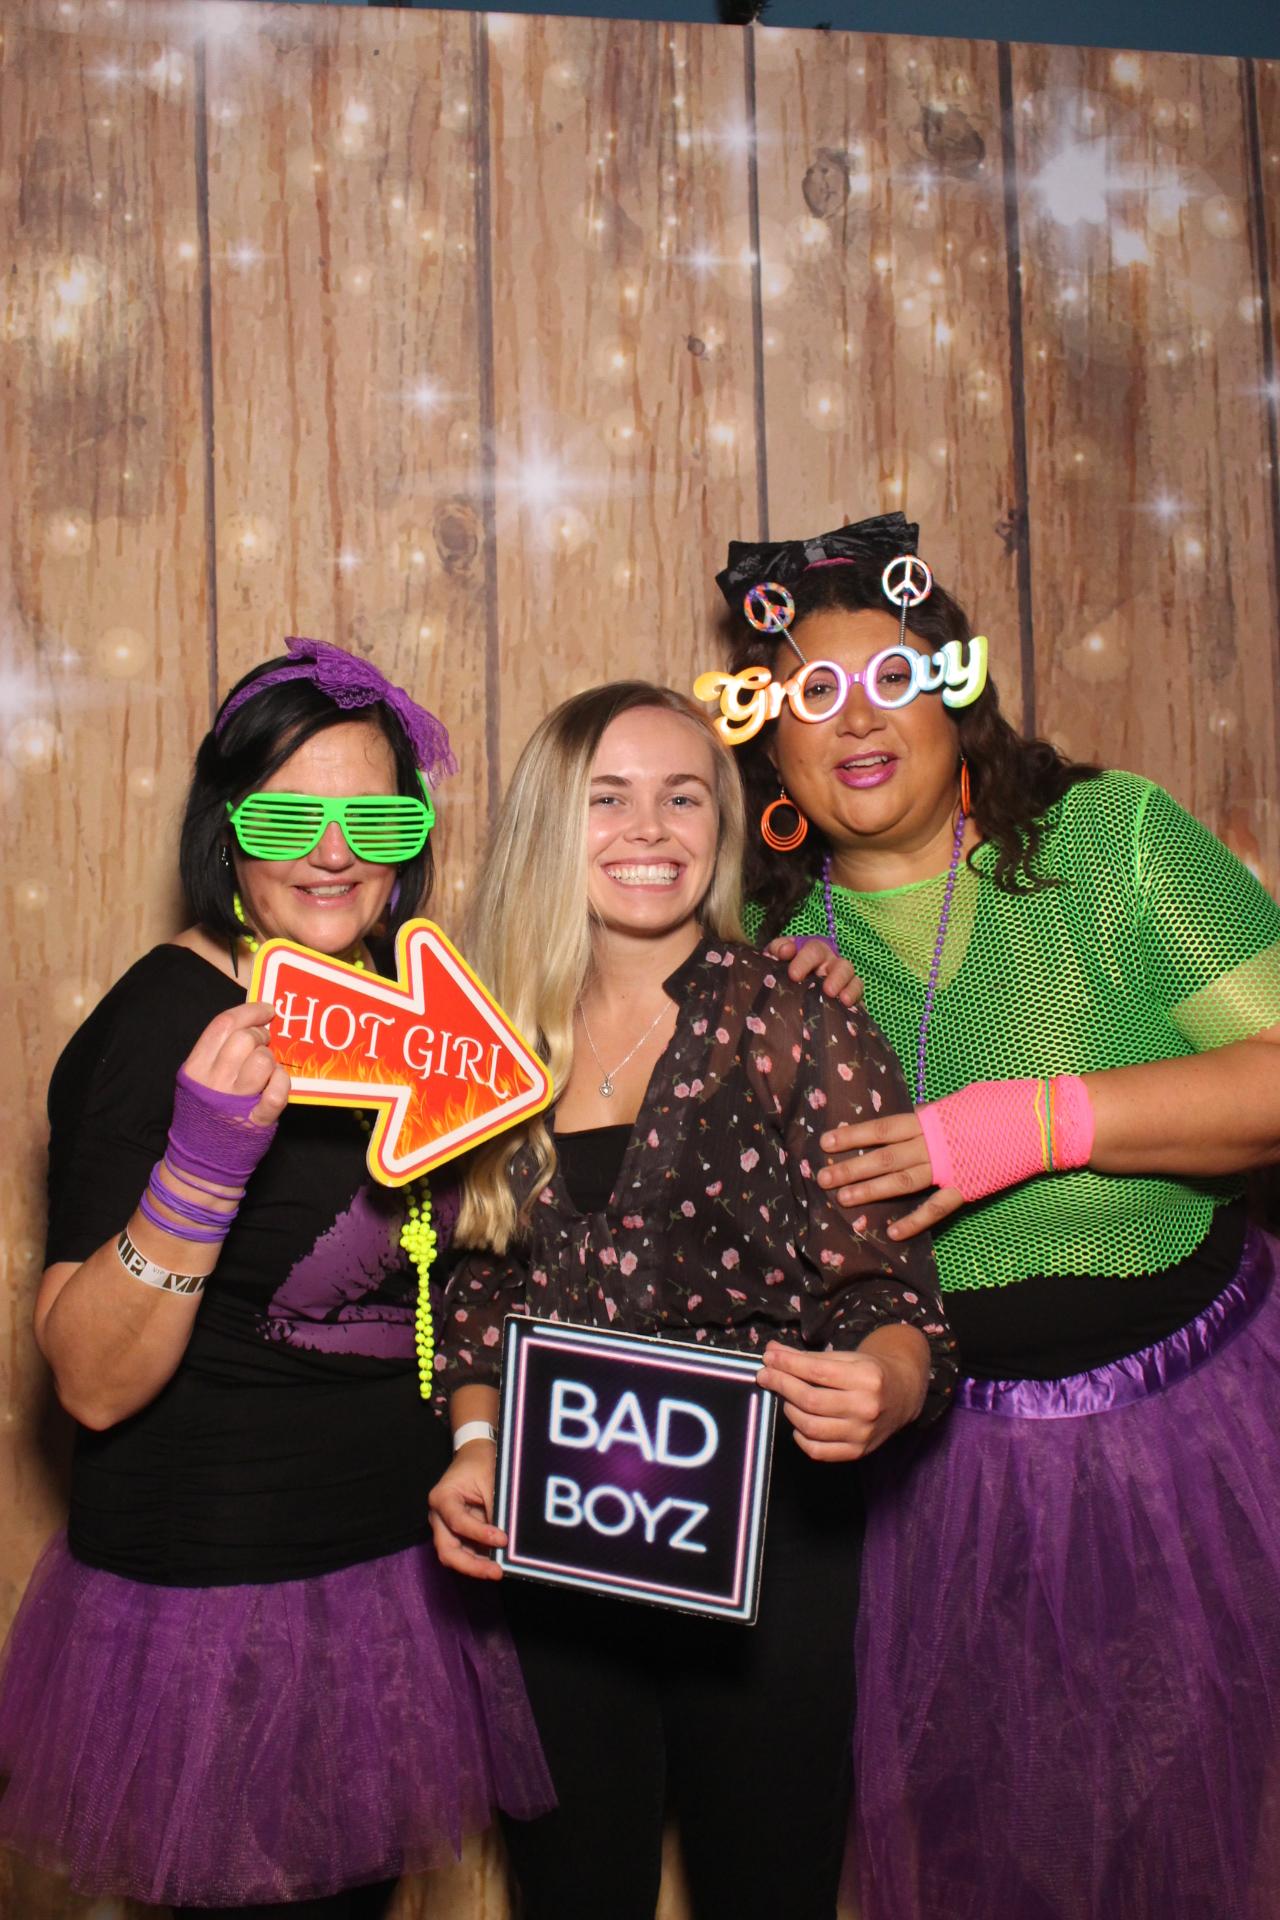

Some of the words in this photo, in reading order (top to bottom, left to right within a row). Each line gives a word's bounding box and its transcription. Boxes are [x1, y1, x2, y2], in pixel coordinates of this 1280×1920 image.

[274, 991, 395, 1059] HOT
[402, 1025, 509, 1099] GIRL
[549, 1379, 719, 1468] BAD
[545, 1476, 709, 1553] BOYZ
